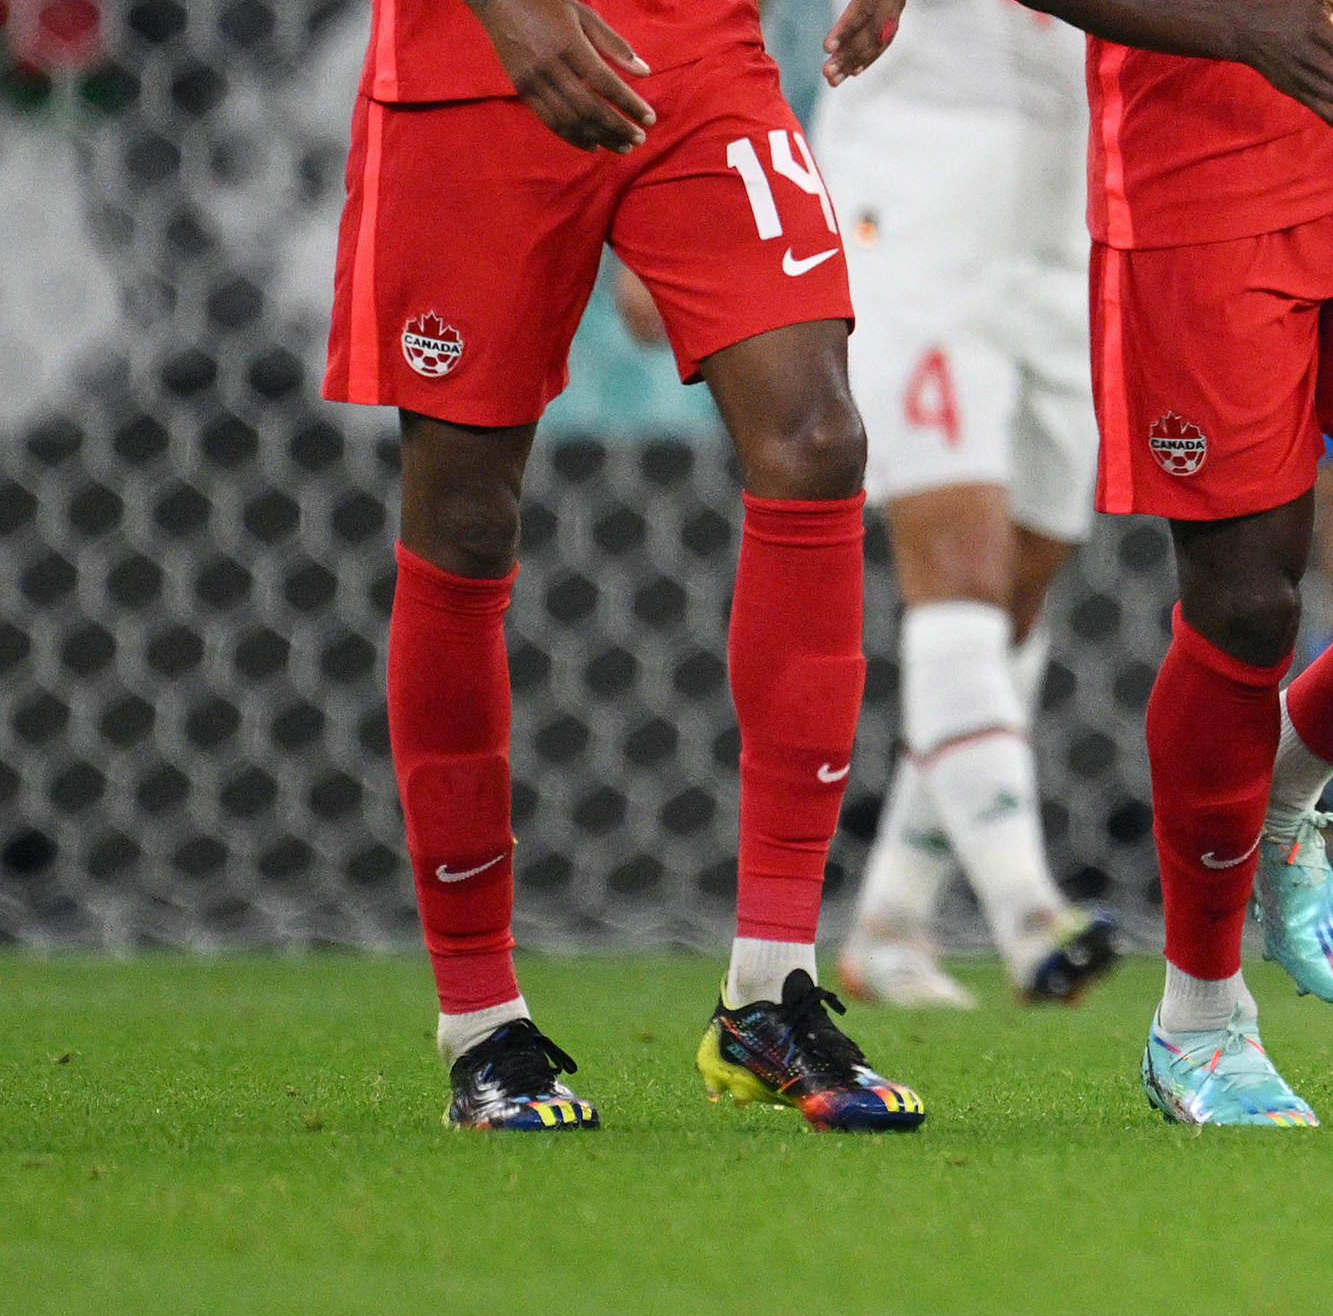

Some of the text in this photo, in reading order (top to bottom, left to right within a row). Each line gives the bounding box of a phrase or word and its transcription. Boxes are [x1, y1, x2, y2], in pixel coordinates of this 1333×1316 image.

[726, 130, 838, 240] 14
[404, 335, 460, 354] CANADA
[904, 346, 961, 449] 4
[1151, 439, 1205, 450] CANADA
